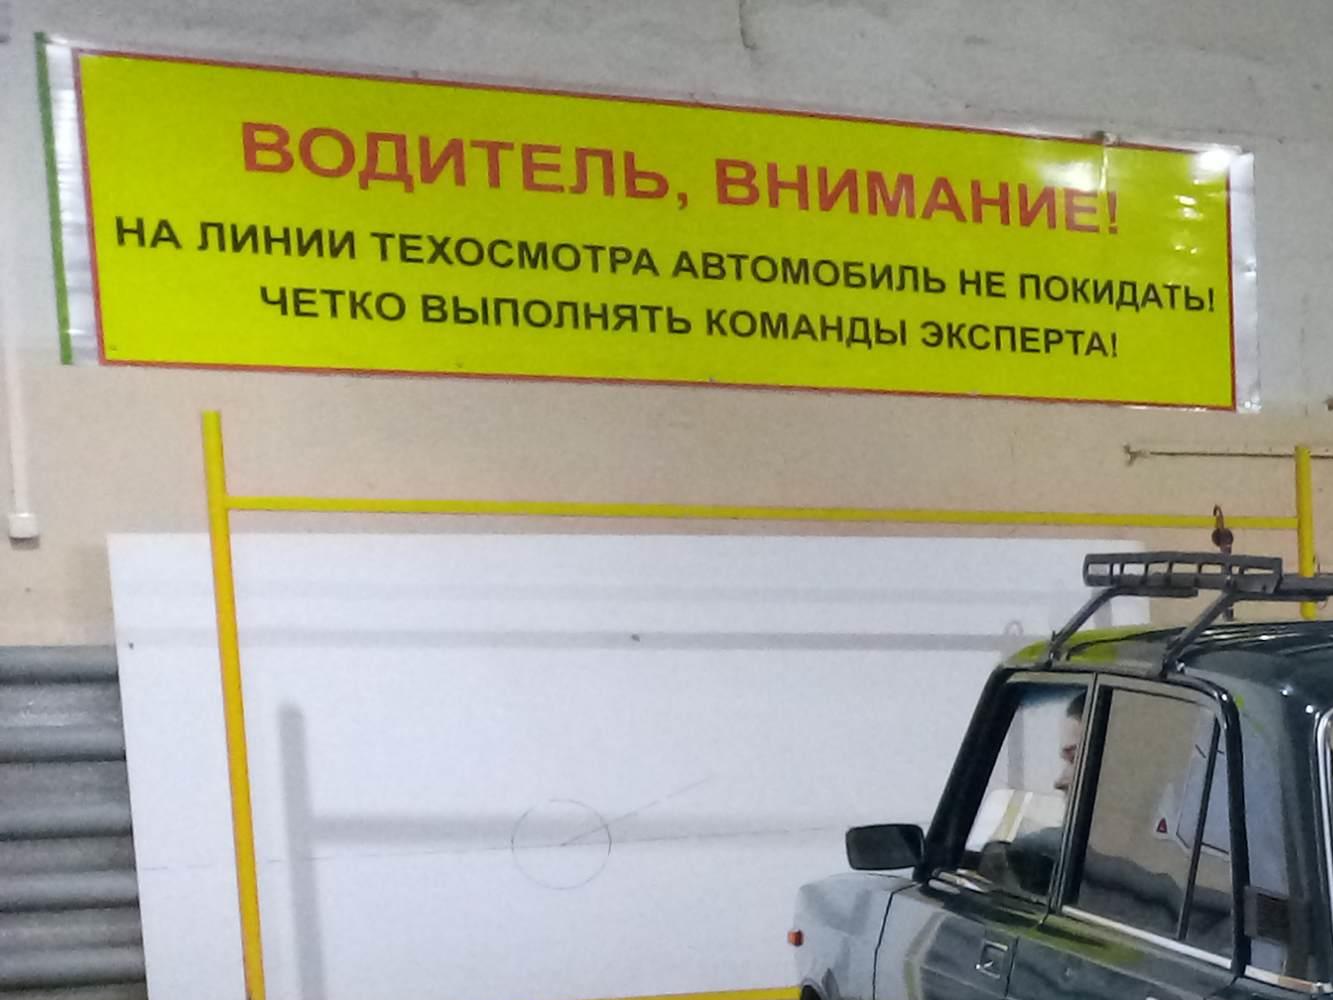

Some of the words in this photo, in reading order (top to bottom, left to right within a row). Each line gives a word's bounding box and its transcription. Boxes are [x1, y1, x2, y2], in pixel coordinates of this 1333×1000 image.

[242, 121, 689, 210] ВОДИТЕЛЬ,
[715, 158, 1119, 236] ВНИМАНИЕ!
[116, 216, 182, 249] НА
[197, 221, 356, 260] ЛИНИИ
[370, 231, 660, 277] ТЕХОСМОТРА
[671, 250, 947, 294] АВТОМОБИЛЬ
[959, 269, 1007, 299] НЕ
[1019, 273, 1216, 313] ПОКИДАТЬ!
[260, 286, 406, 322] ЧЕТКО
[421, 294, 692, 335] ВЫПОЛНЯТЬ
[705, 308, 907, 350] КОМАНДЫ
[920, 320, 1118, 358] ЭКСПЕРТА!
